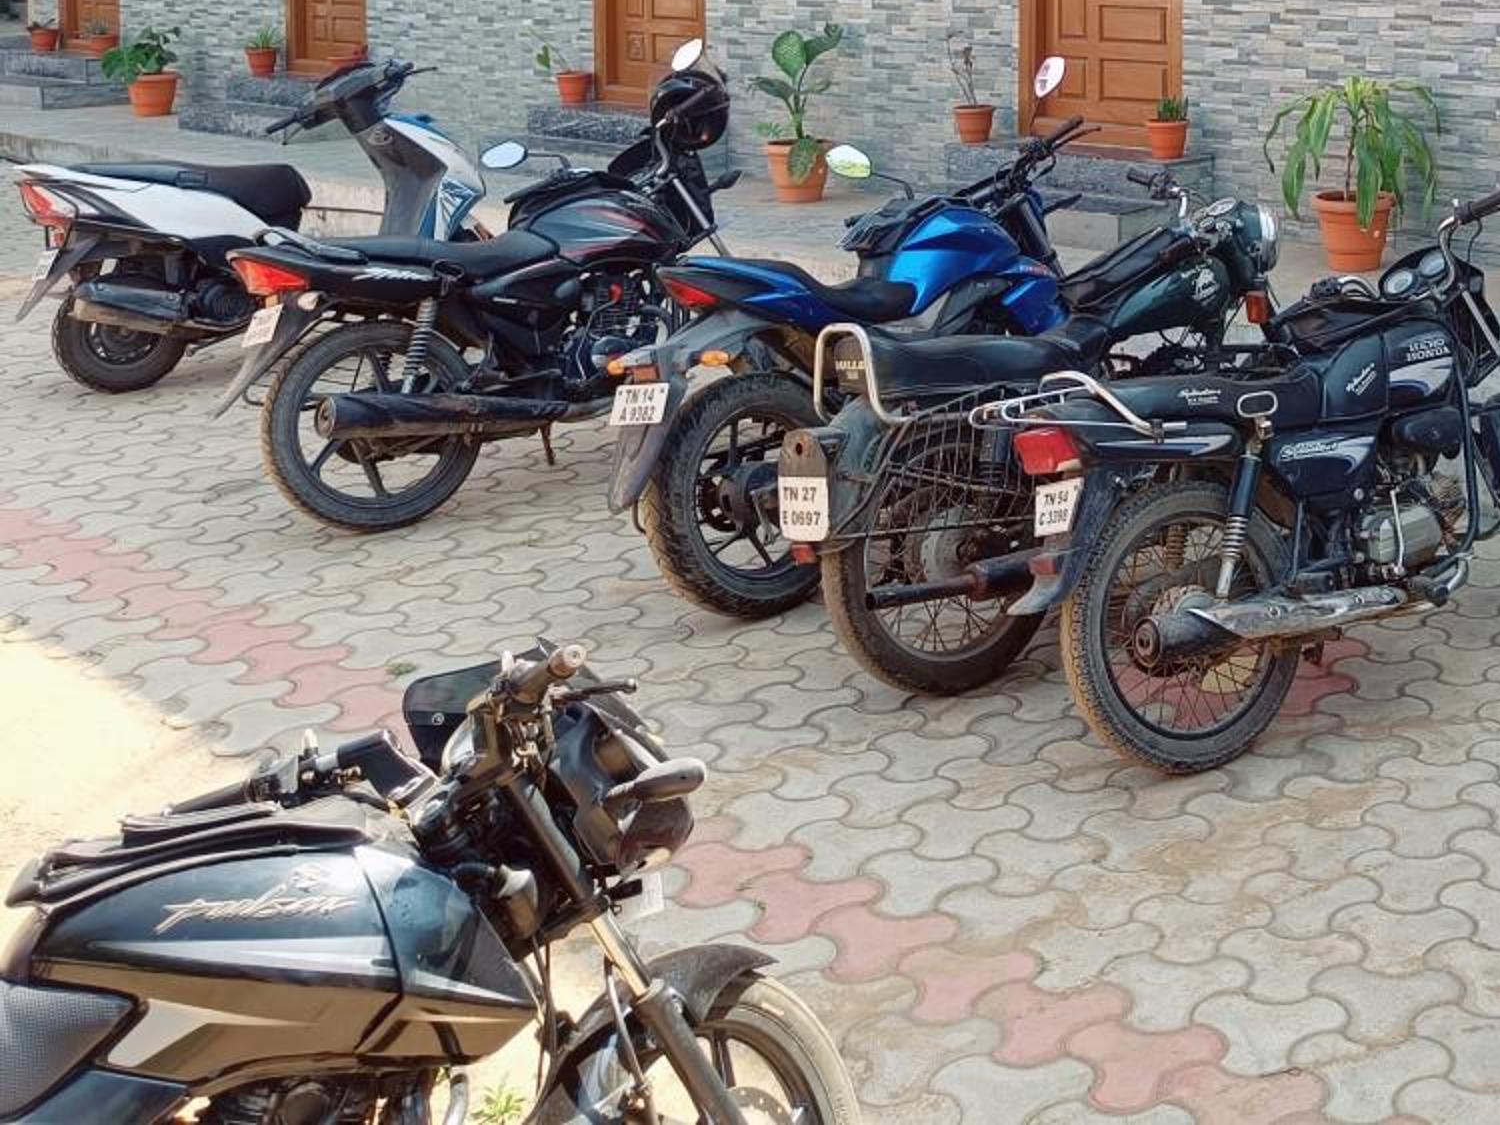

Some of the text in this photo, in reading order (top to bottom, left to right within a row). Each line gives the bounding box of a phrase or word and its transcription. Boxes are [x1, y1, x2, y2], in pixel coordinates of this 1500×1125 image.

[1406, 346, 1451, 362] HONDA
[626, 388, 655, 403] TN 14
[783, 486, 817, 503] TN 27
[1044, 492, 1056, 505] TN
[791, 510, 820, 525] 0697
